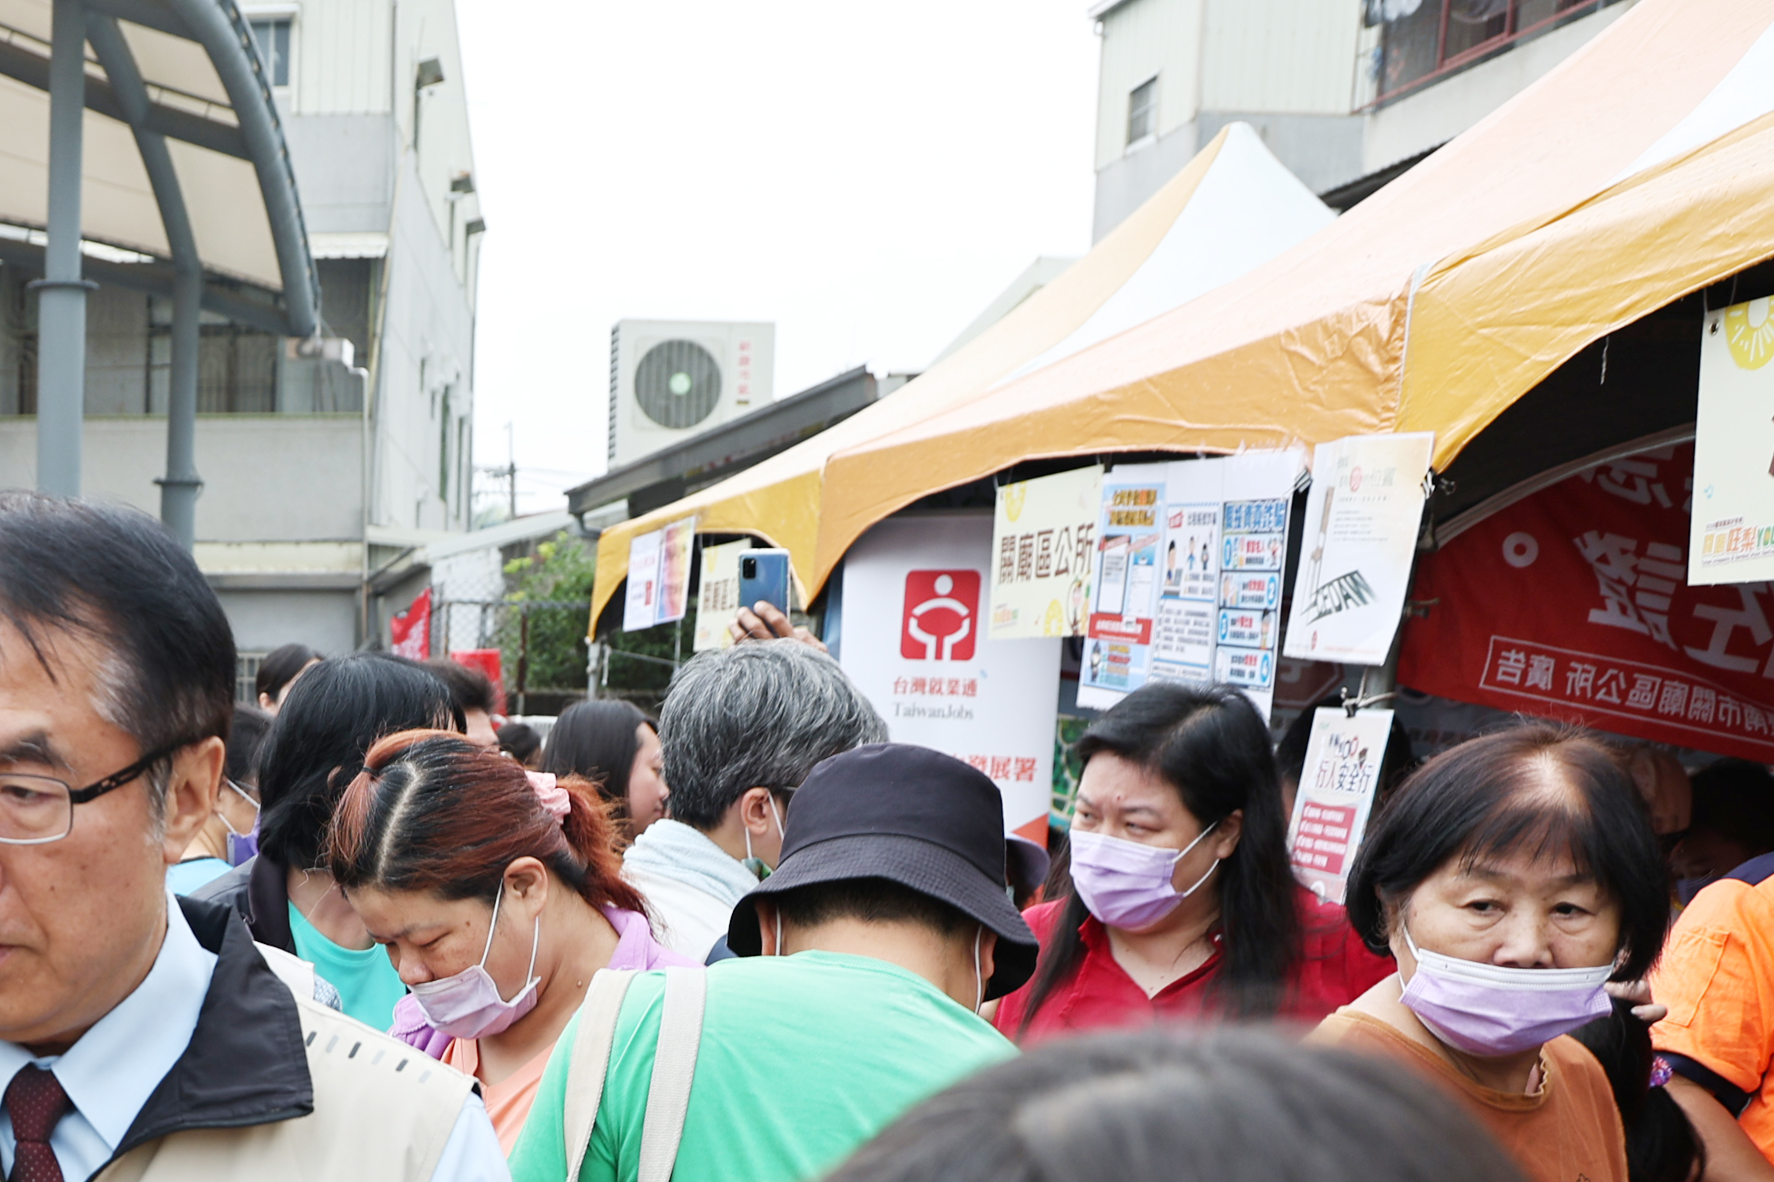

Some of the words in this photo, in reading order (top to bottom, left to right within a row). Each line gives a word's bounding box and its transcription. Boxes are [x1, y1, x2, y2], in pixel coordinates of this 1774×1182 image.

[893, 676, 978, 698] 台灣就業通
[893, 702, 975, 720] TaiwanJobs
[953, 753, 1037, 782] 發展署
